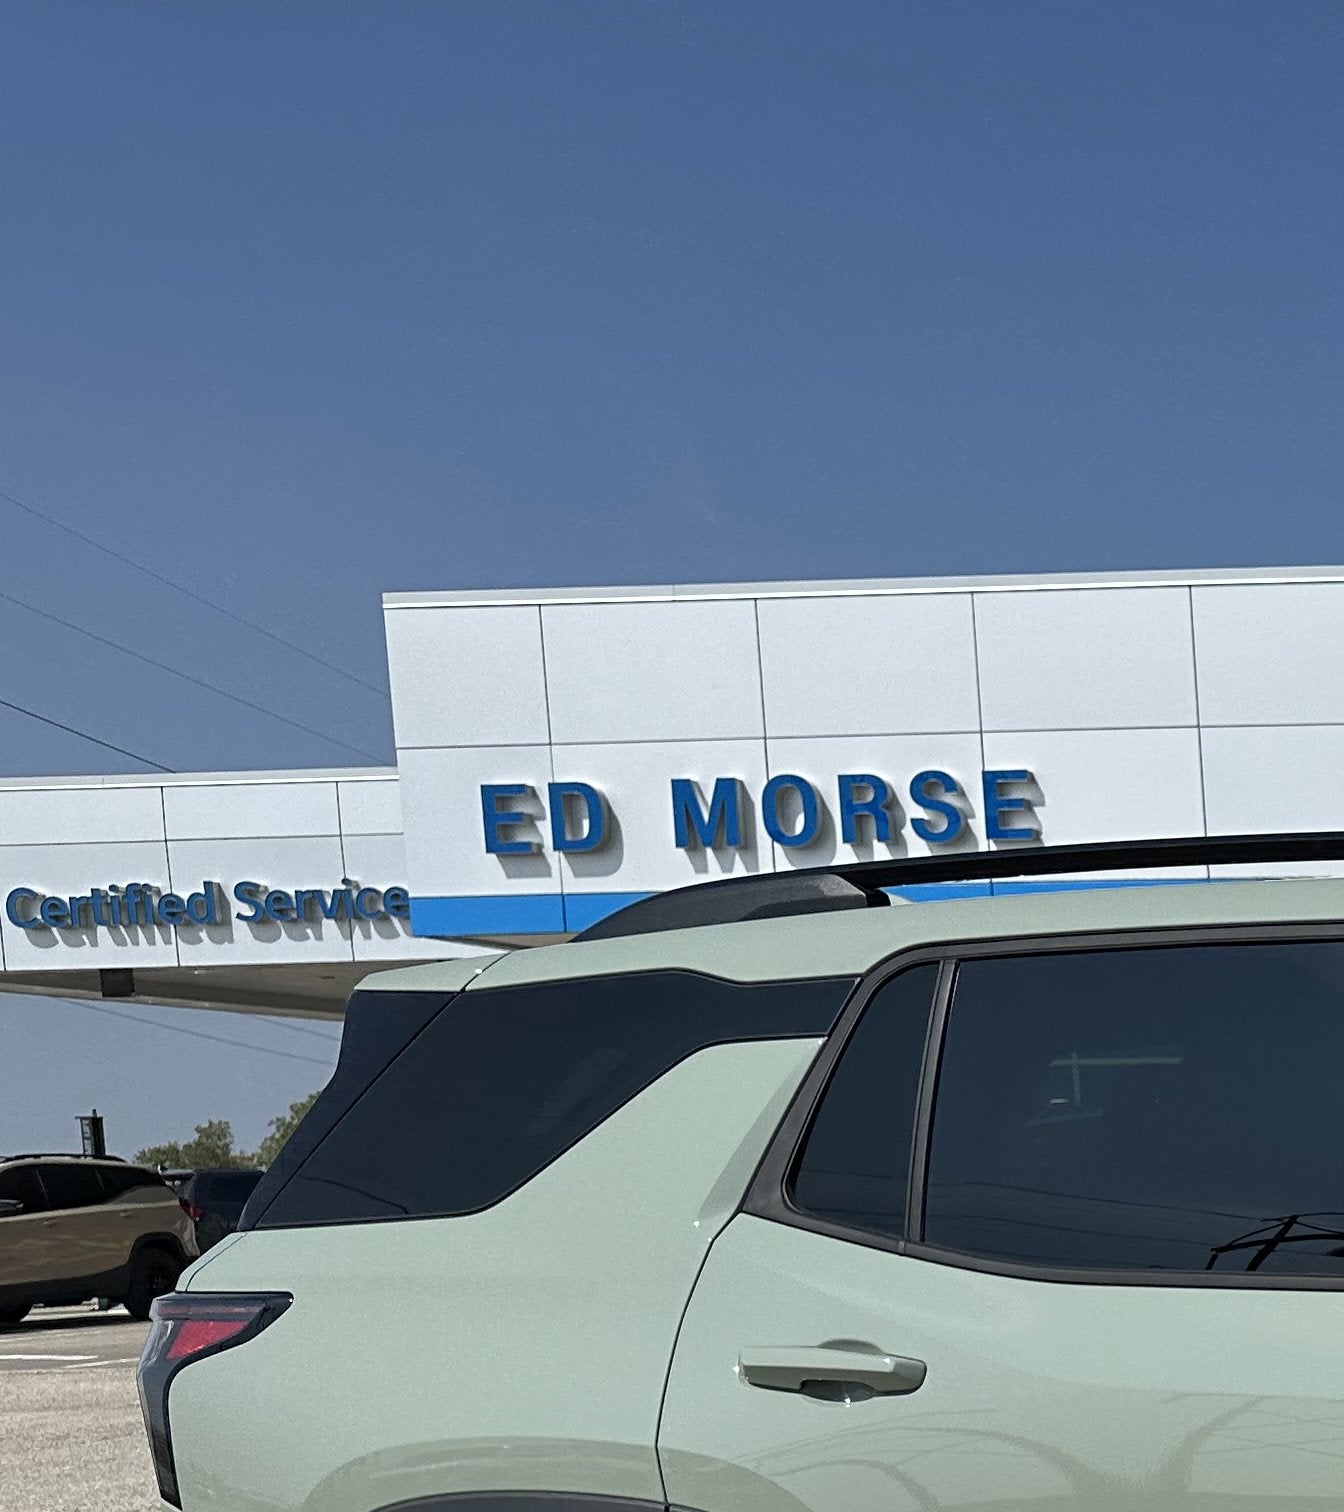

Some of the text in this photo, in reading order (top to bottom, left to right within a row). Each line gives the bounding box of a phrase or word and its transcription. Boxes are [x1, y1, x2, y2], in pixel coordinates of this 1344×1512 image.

[480, 770, 1039, 854] ED MORSE
[6, 878, 410, 929] Certified Service
